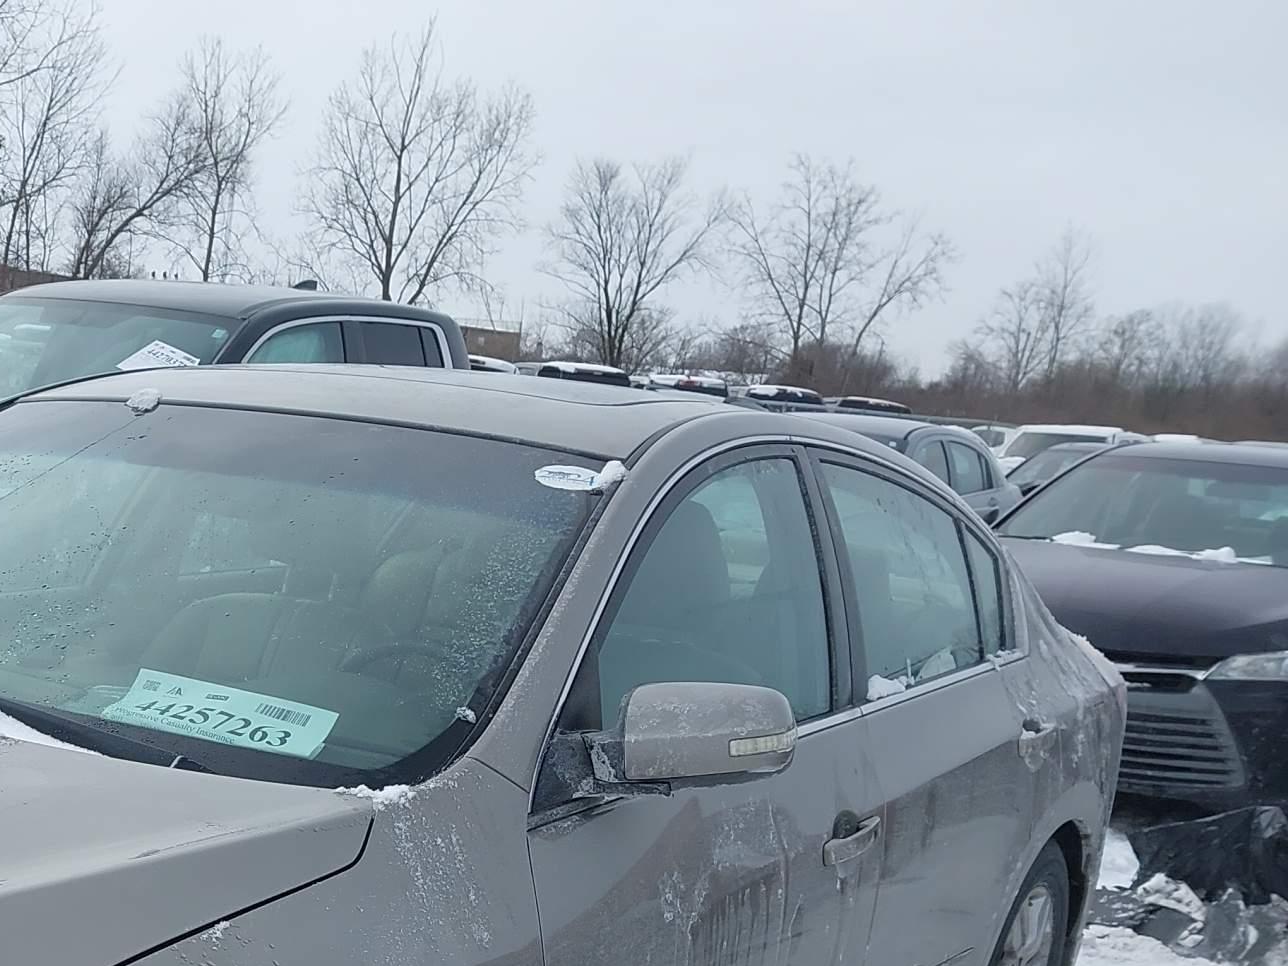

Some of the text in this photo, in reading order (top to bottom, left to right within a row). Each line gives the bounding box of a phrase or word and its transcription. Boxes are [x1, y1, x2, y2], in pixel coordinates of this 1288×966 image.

[134, 699, 293, 748] 44257263
[160, 717, 195, 734] Casualty
[196, 727, 236, 745] Insurance
